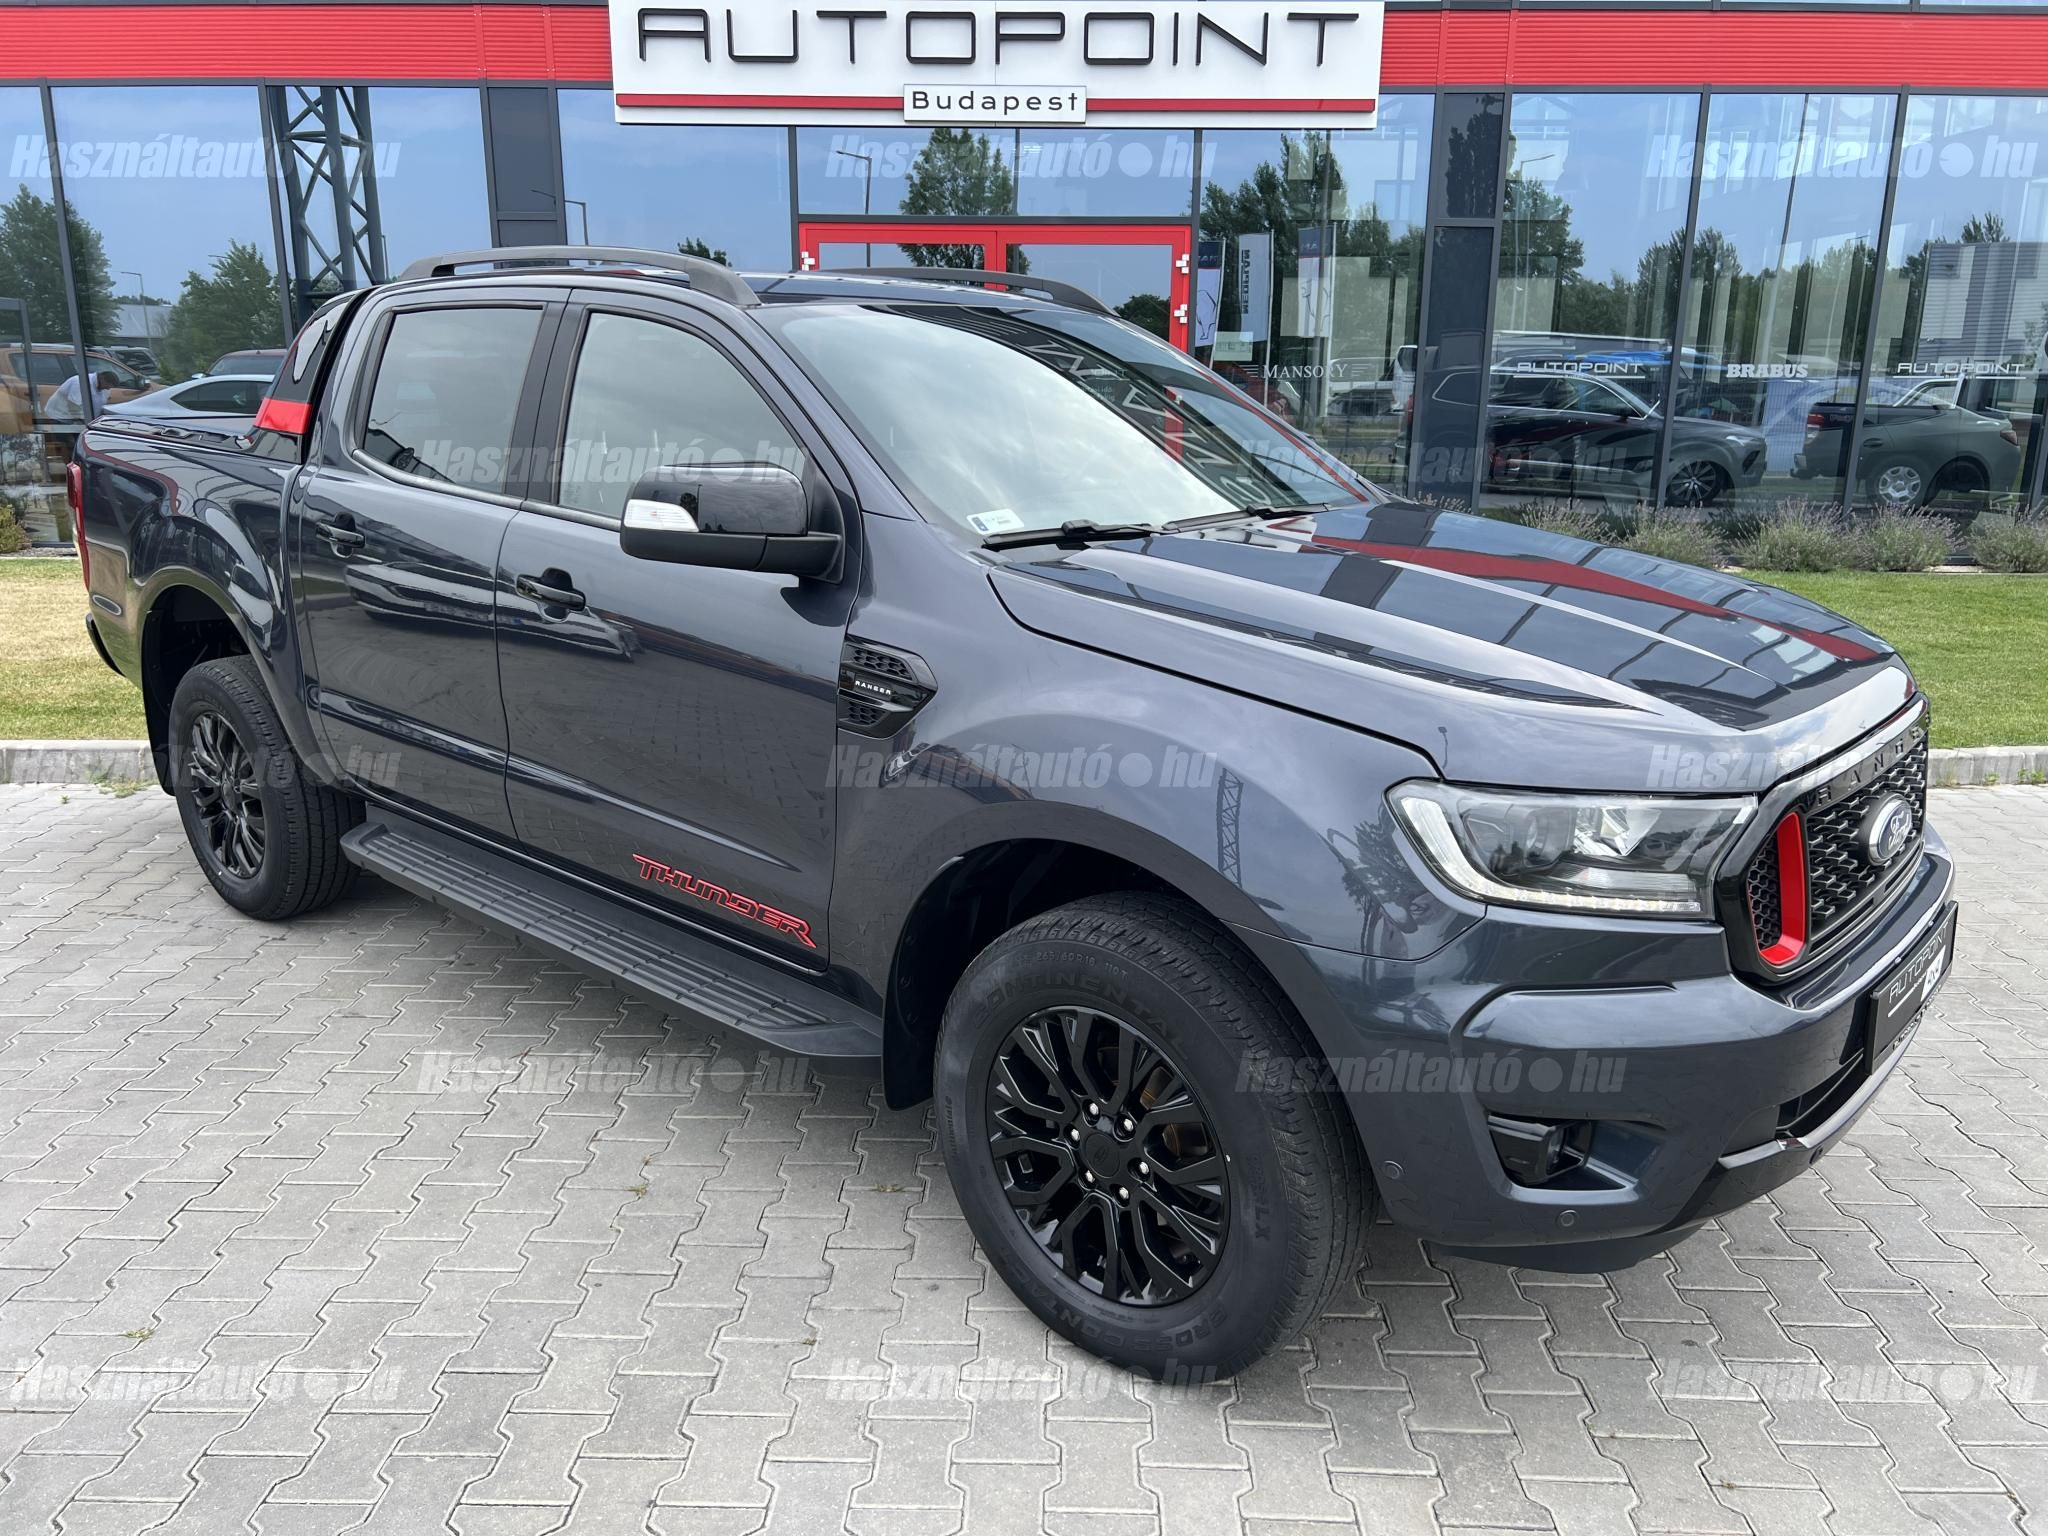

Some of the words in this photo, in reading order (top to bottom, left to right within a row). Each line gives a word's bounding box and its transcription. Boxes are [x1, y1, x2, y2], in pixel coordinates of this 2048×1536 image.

[637, 8, 1359, 67] AUTOPOINT
[912, 90, 1078, 115] Budapest
[1263, 364, 1348, 378] MANSORY
[1516, 362, 1643, 374] AUTOPOINT
[1726, 363, 1809, 378] BRABUS
[1897, 362, 2025, 375] AUTOPOINT
[854, 680, 891, 695] RANGER
[632, 853, 817, 948] THUNDER
